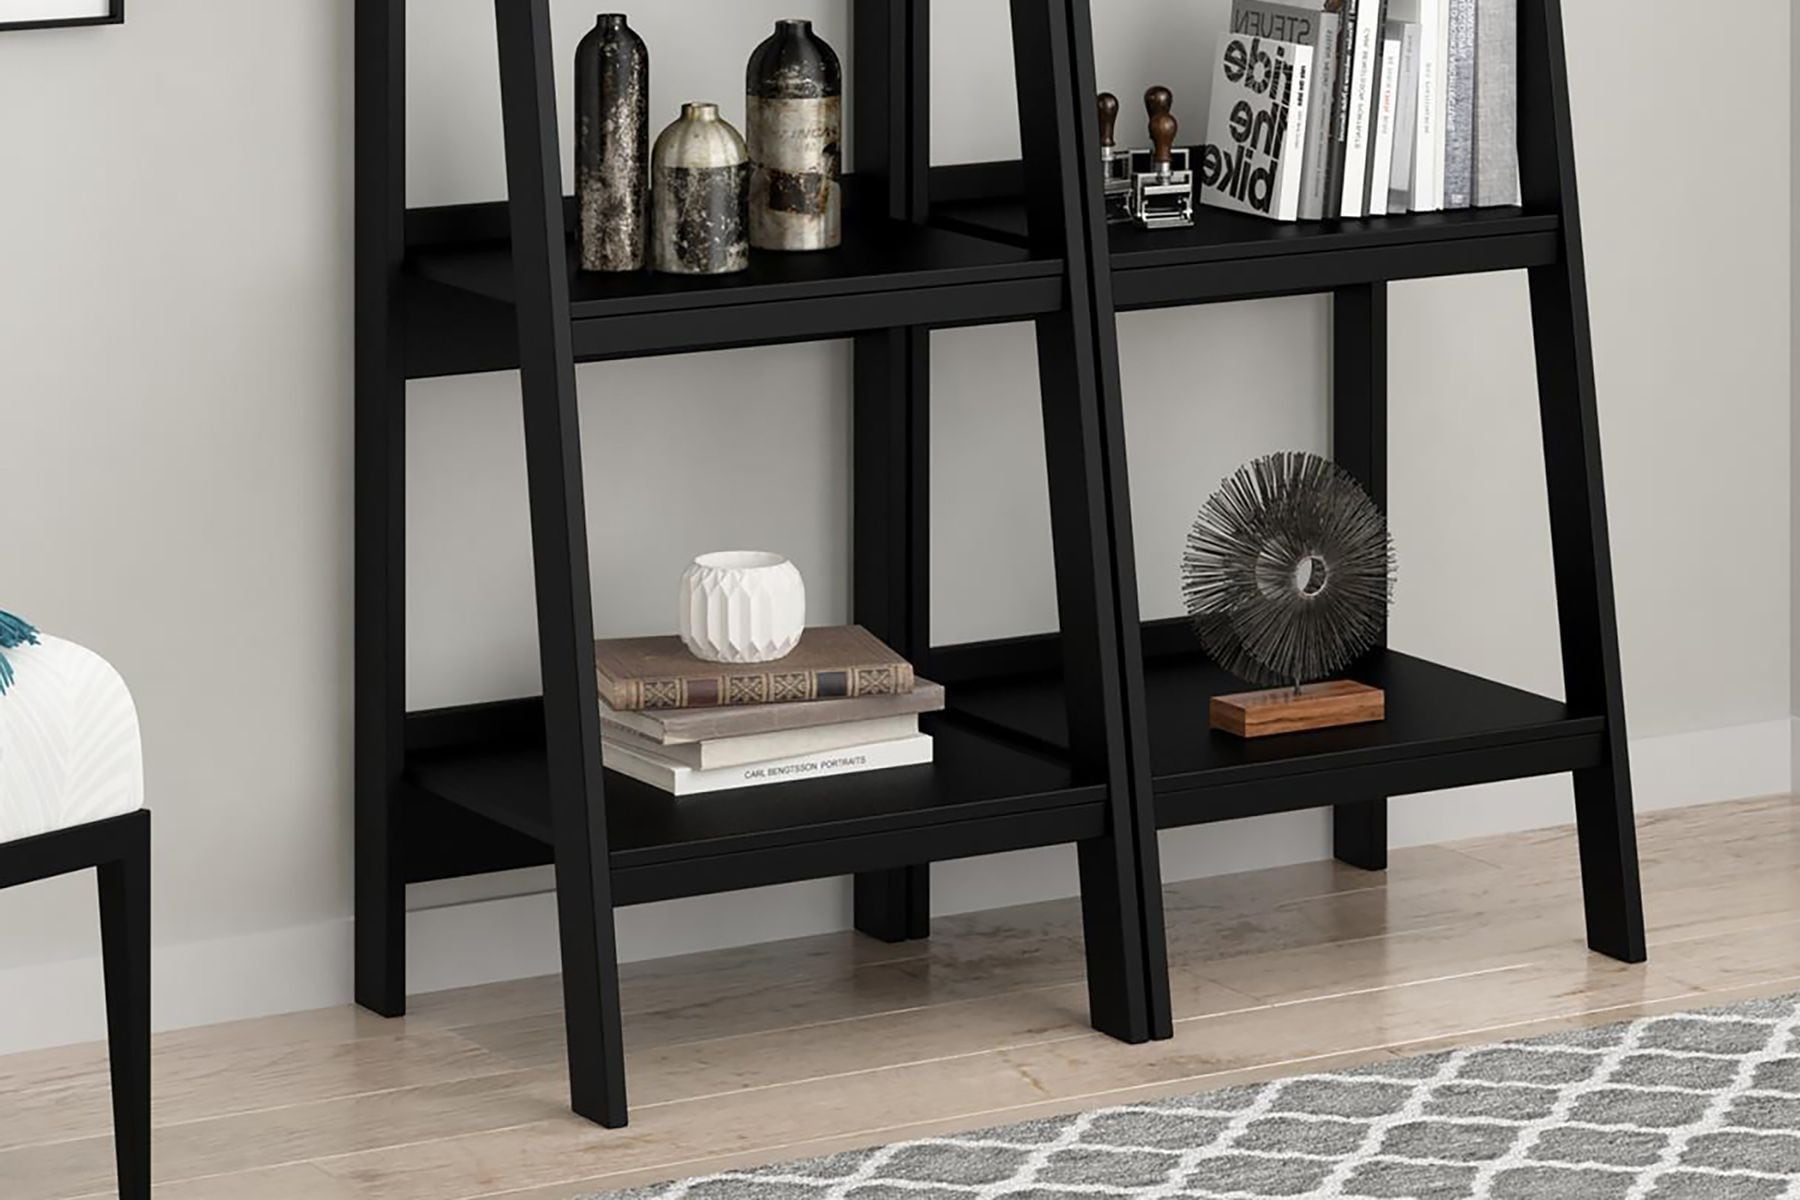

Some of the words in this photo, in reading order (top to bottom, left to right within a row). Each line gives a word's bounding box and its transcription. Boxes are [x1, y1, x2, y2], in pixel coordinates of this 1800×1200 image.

[744, 771, 766, 779] CARL
[767, 763, 818, 776] BENGTSSON
[820, 755, 866, 769] PORTRAITS
